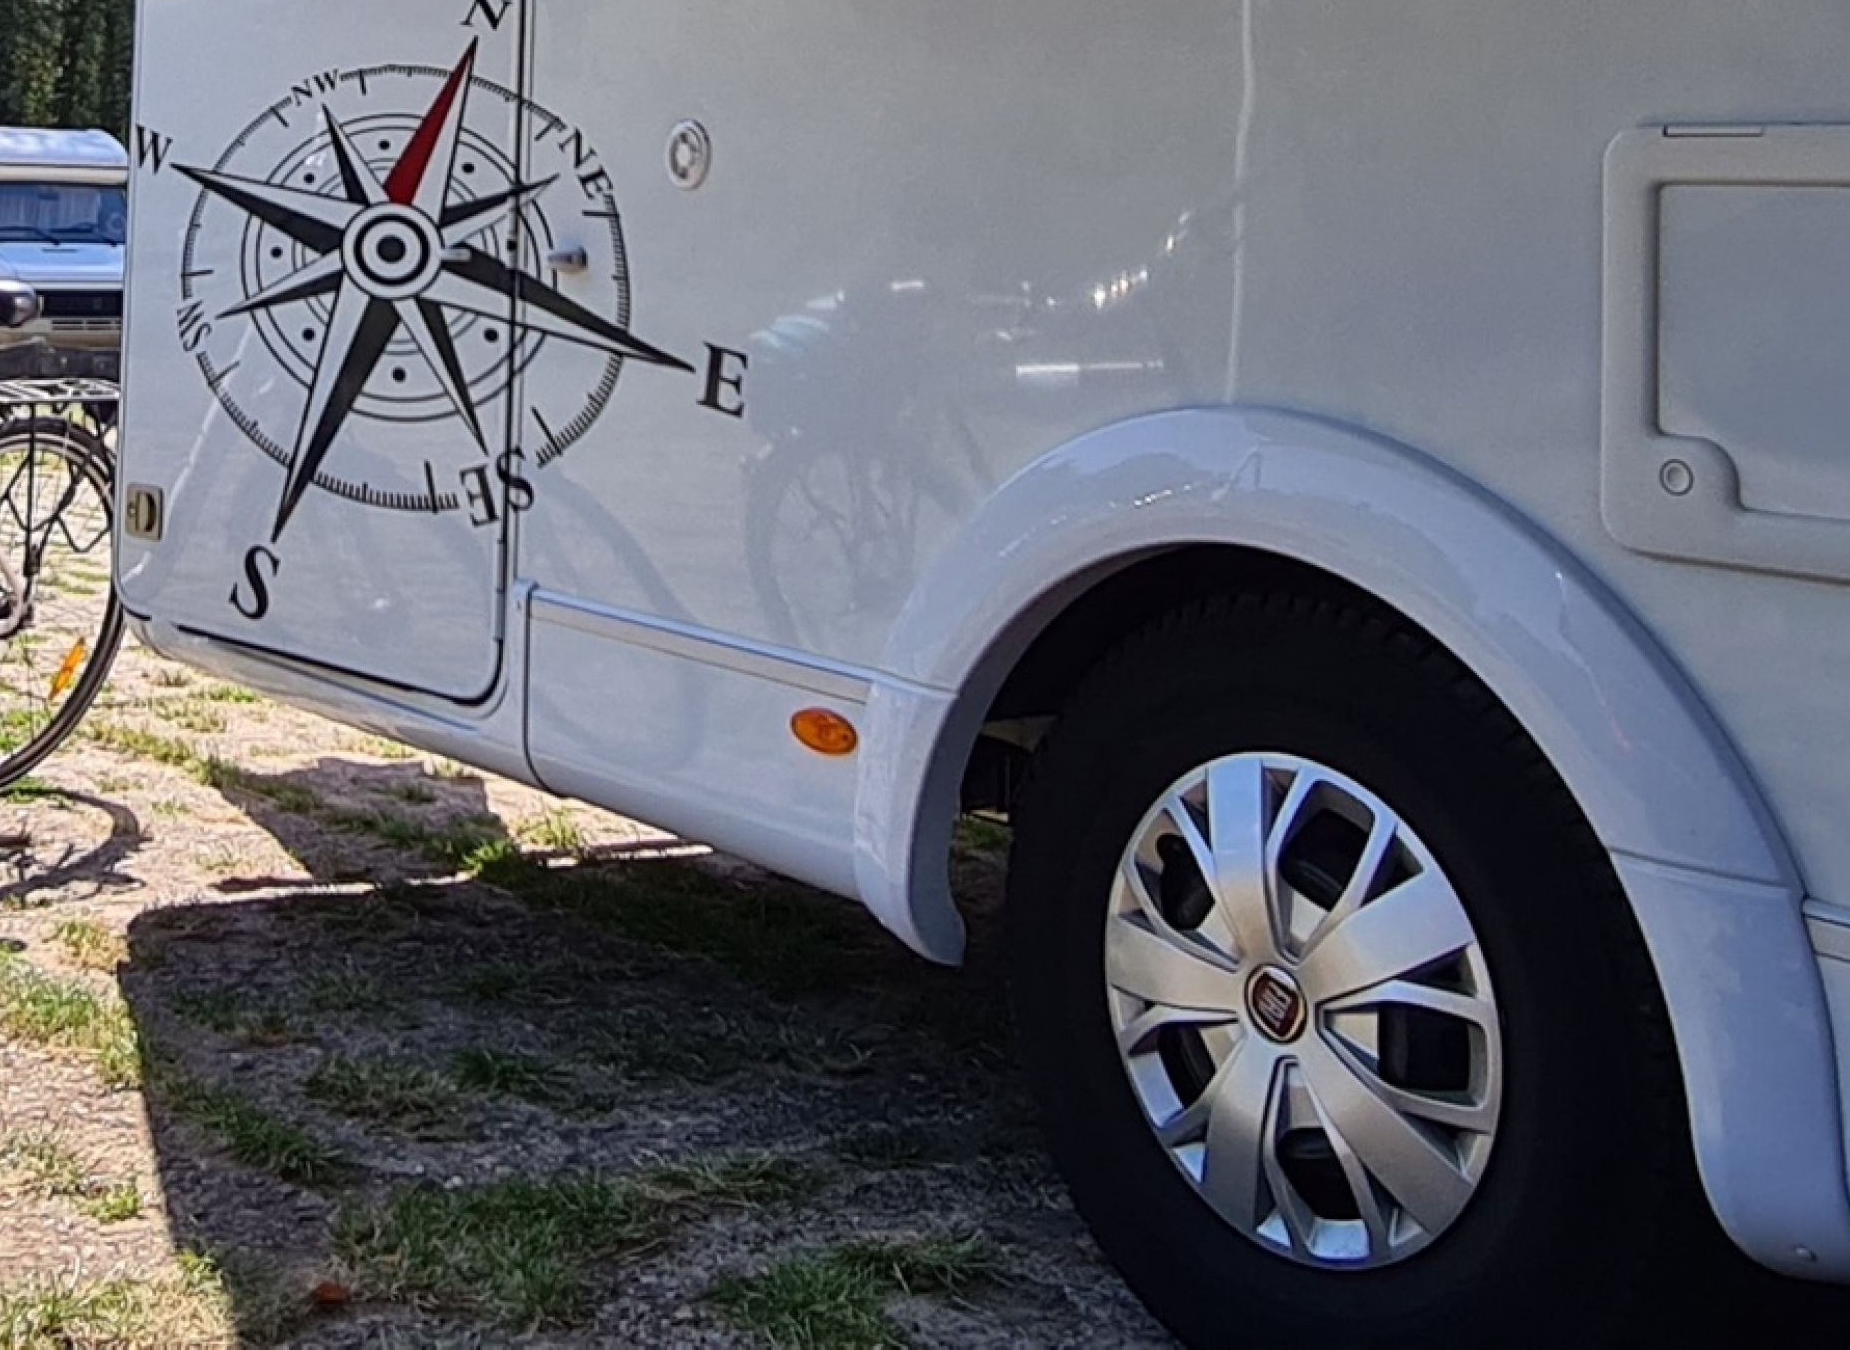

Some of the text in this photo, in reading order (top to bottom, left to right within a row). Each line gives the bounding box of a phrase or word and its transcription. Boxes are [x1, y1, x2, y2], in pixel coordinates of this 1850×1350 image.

[291, 67, 339, 107] NW
[135, 121, 174, 175] W
[557, 126, 614, 200] NE
[176, 299, 213, 352] SW
[695, 340, 748, 419] E
[228, 543, 281, 621] S
